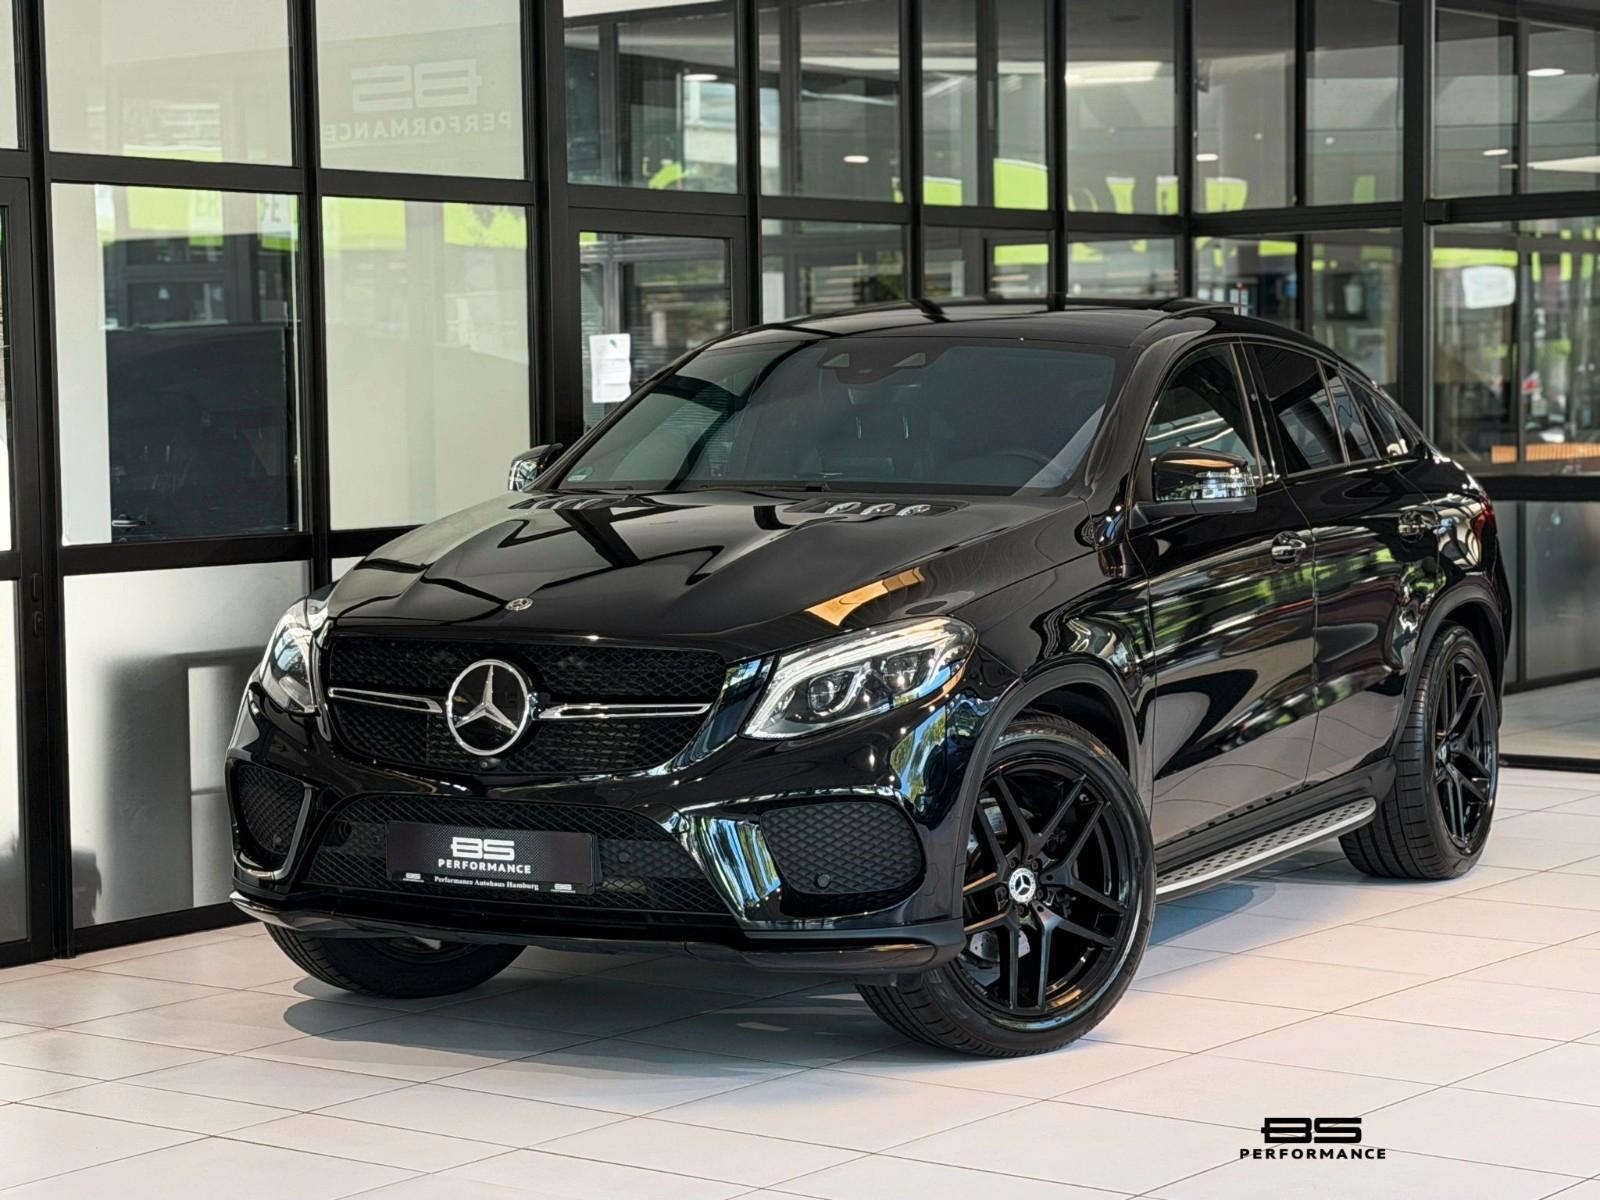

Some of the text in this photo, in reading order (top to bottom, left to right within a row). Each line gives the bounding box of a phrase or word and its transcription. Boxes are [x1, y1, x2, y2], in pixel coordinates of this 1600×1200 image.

[450, 837, 515, 861] BS
[438, 858, 531, 874] PERFORMANCE
[434, 876, 473, 886] Performance
[474, 880, 505, 888] Autohaus
[506, 881, 539, 891] Hamburg
